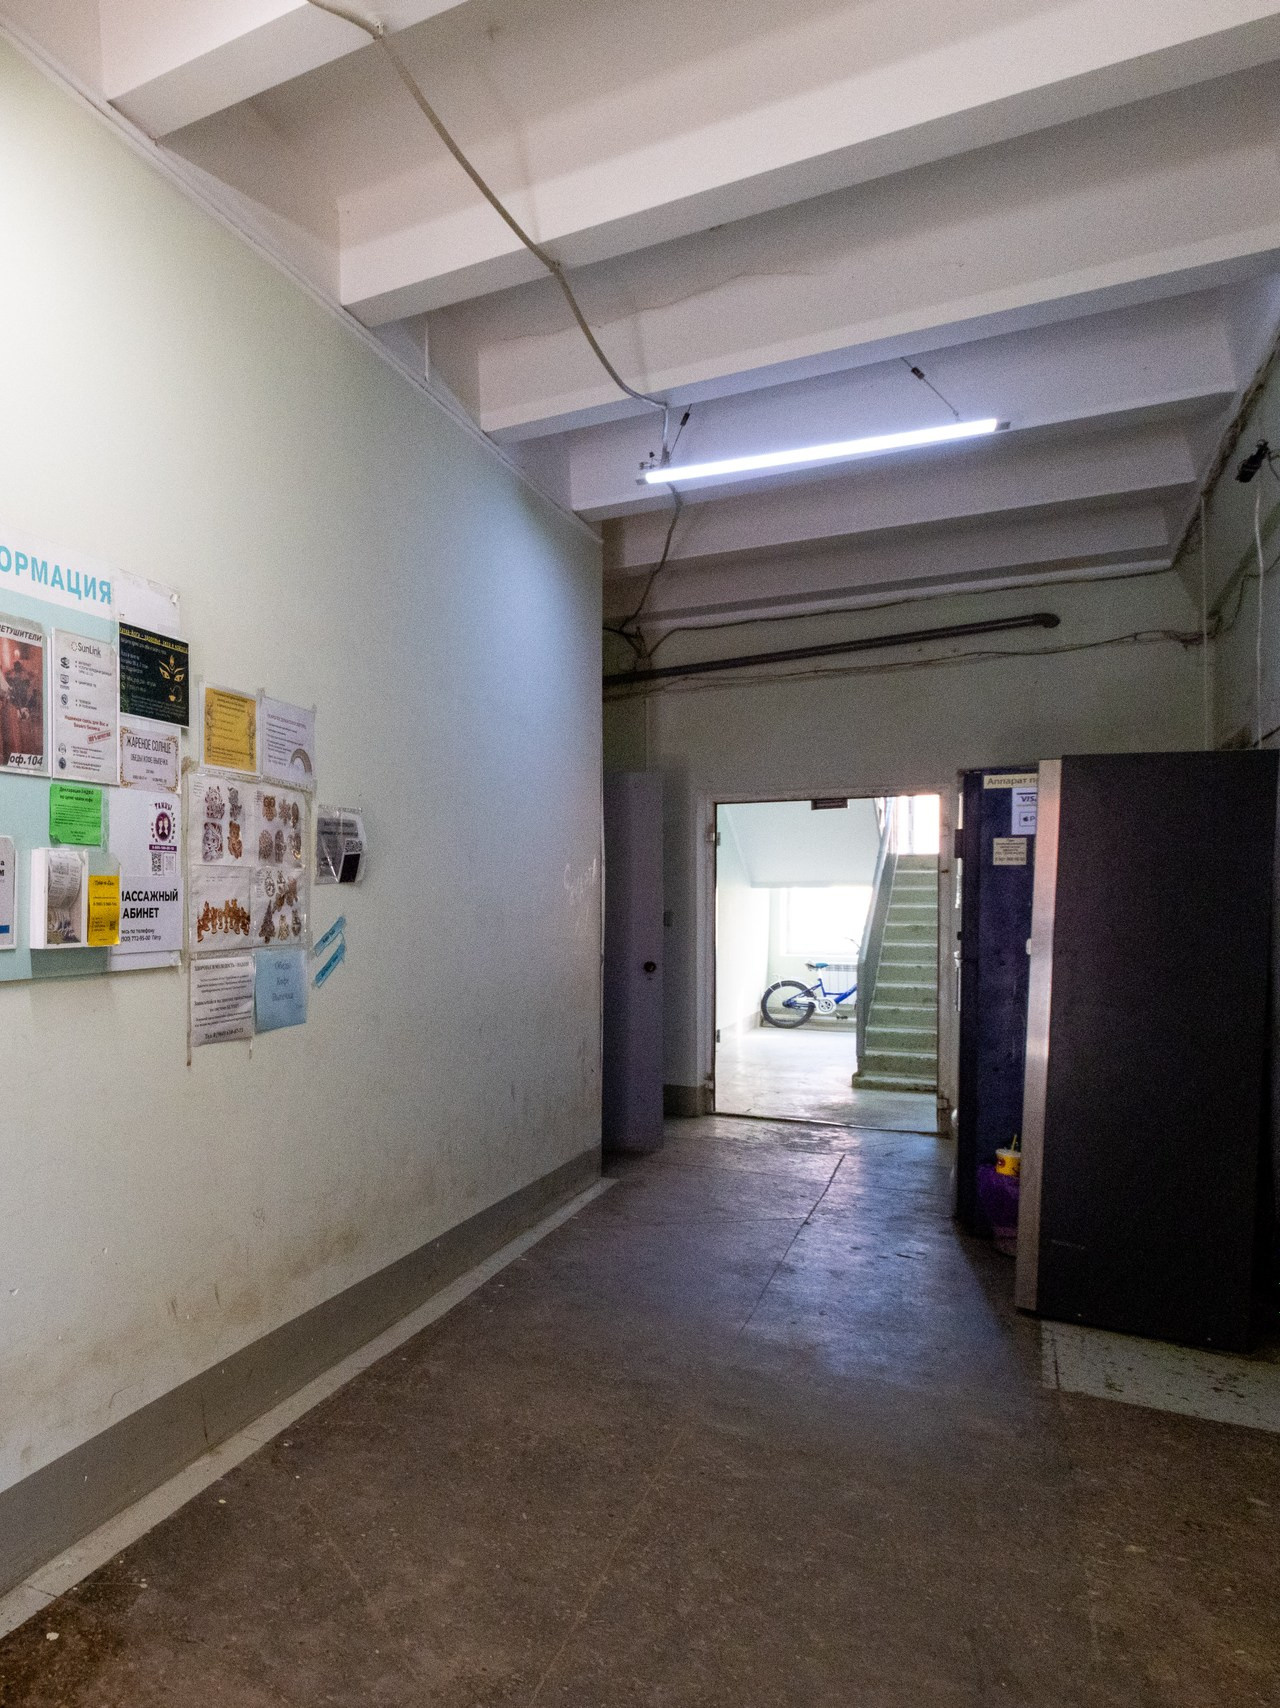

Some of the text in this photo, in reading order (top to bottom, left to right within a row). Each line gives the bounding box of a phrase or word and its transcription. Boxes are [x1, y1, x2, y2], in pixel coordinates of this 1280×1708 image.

[9, 753, 43, 767] оф.104
[987, 777, 1027, 786] Аппарат
[122, 907, 160, 919] АБИНЕТ
